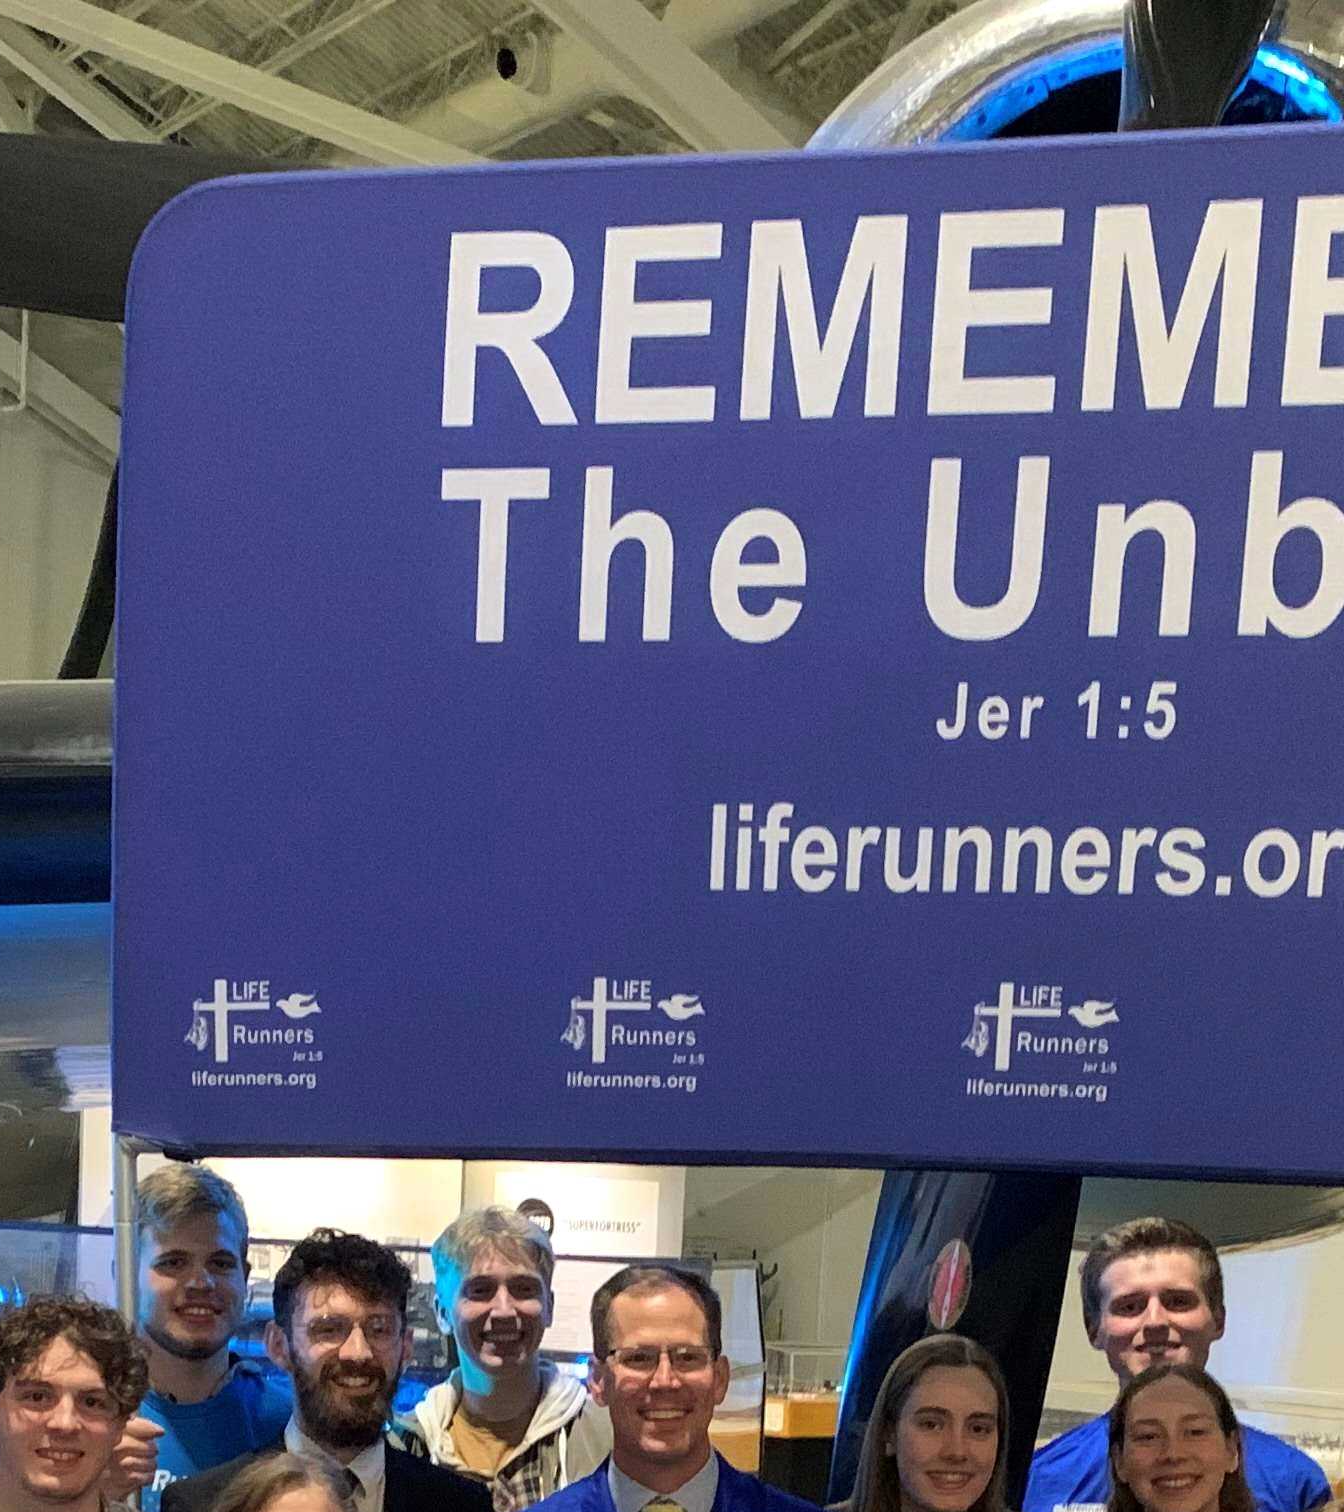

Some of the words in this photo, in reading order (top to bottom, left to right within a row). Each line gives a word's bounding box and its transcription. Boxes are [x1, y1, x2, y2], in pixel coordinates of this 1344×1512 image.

[442, 467, 807, 643] The
[937, 683, 1045, 742] Jer
[1077, 681, 1179, 741] 1:5
[232, 981, 271, 1000] LIFE
[612, 980, 652, 1000] LIFE
[1019, 986, 1063, 1007] LIFE
[233, 1025, 315, 1045] Runners
[612, 1025, 697, 1046] Runners
[1017, 1032, 1109, 1055] Runners
[192, 1071, 317, 1088] liferunners.org
[567, 1071, 697, 1092] liferunners.org
[966, 1079, 1108, 1102] liferunners.org
